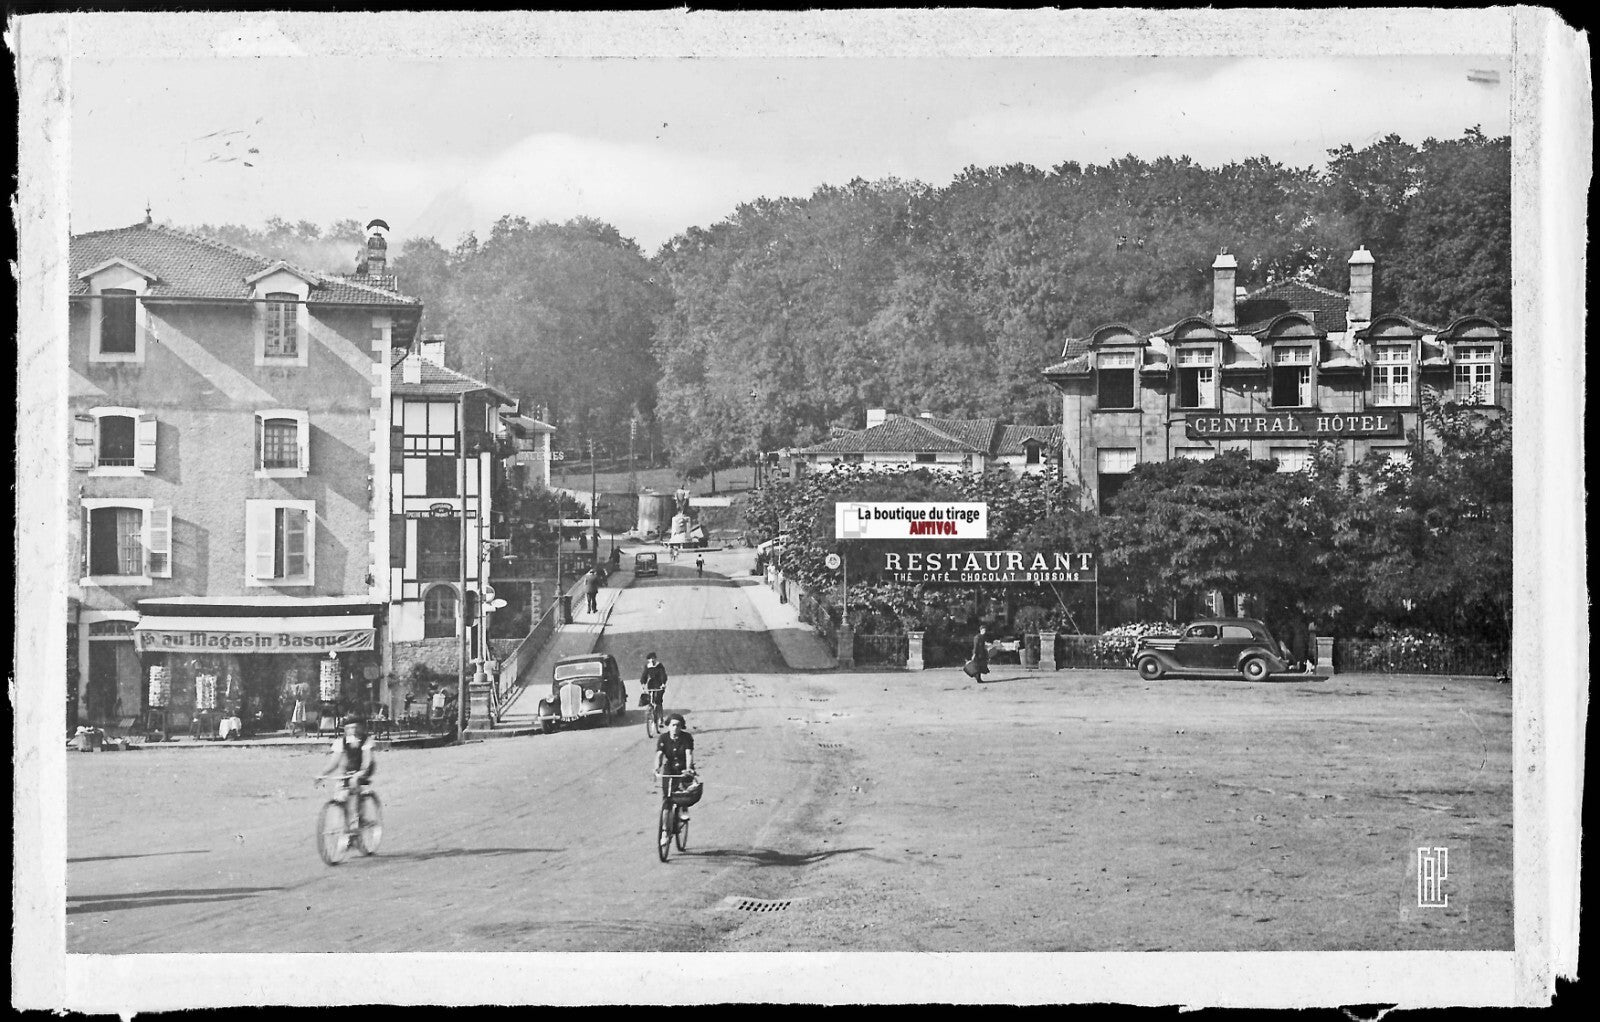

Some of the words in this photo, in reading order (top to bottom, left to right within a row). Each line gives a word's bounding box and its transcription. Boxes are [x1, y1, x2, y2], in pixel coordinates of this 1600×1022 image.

[1195, 417, 1299, 433] CENTRAL
[1316, 414, 1389, 431] HÔTEL
[885, 552, 1092, 570] RESTAURANT
[923, 571, 950, 581] CAFÉ
[961, 572, 1015, 581] CHOCOLAT
[1027, 572, 1079, 581] BOISSONS
[162, 634, 184, 646] au
[189, 632, 272, 649] Magasin
[278, 633, 348, 649] Basque
